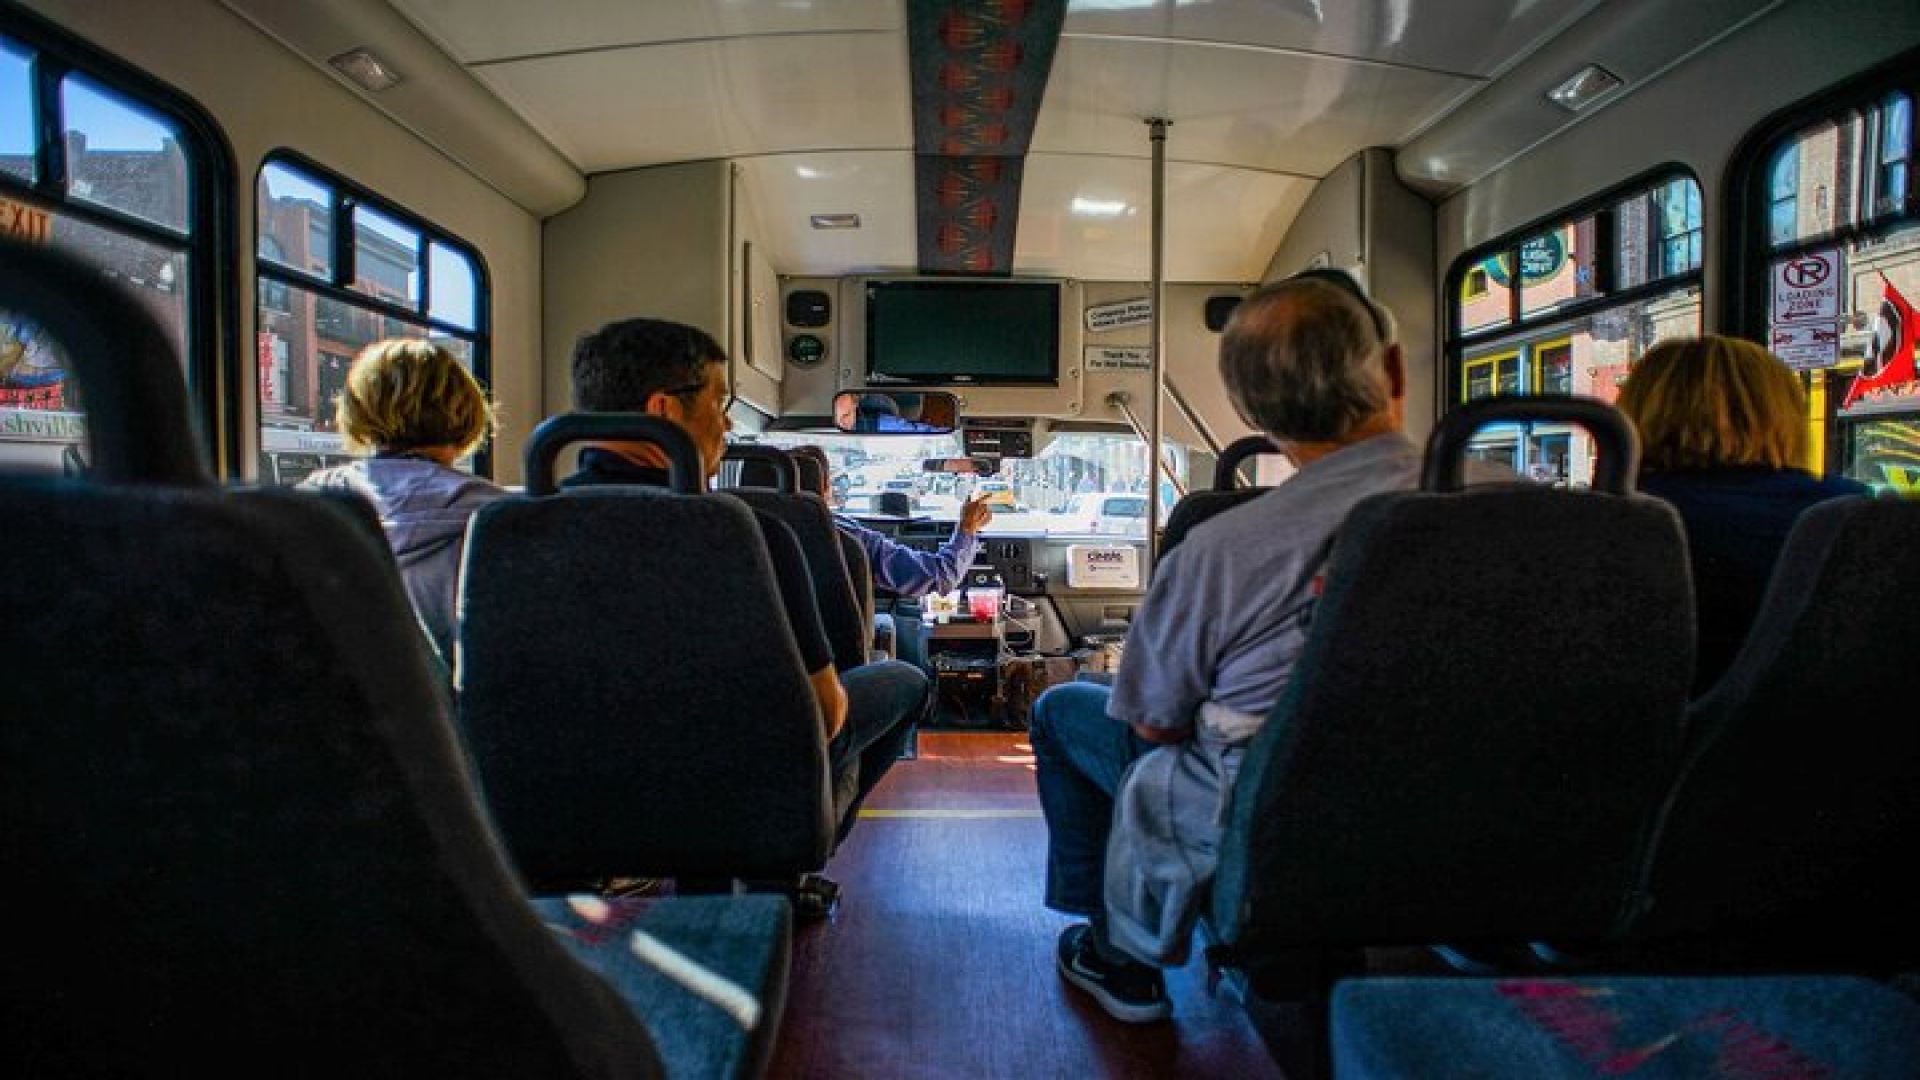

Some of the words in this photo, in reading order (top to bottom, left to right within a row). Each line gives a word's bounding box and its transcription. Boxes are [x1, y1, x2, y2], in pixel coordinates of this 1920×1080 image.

[0, 199, 51, 242] EXIT
[1778, 287, 1834, 303] LOADING
[1788, 299, 1821, 312] ZONE
[1103, 350, 1124, 359] Thank
[1090, 359, 1102, 368] For
[1103, 359, 1118, 368] Not
[1119, 360, 1151, 370] Smoking
